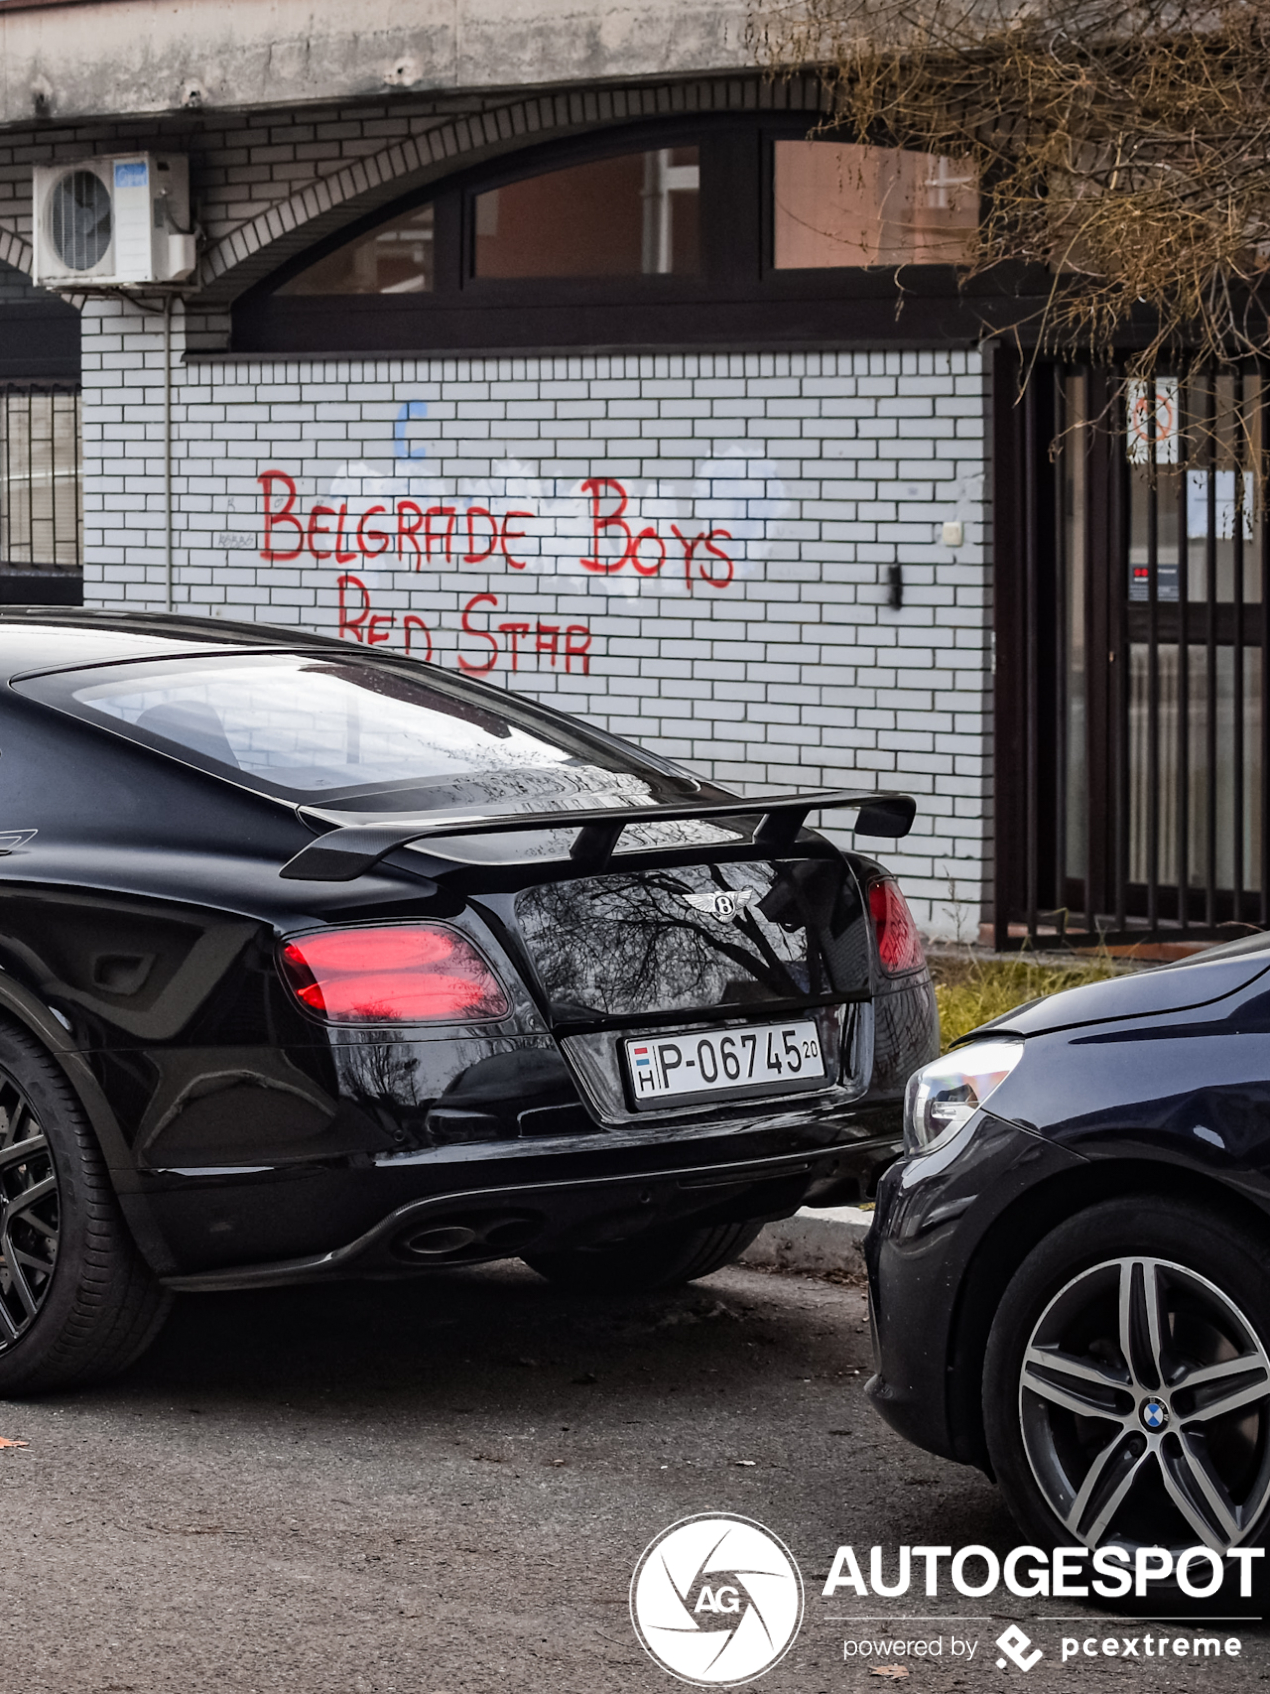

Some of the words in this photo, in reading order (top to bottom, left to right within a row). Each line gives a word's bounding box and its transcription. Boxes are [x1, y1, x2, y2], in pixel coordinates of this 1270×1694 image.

[256, 469, 536, 573] BELGRADE
[457, 591, 594, 677] STAR
[638, 1069, 655, 1092] H
[657, 1030, 802, 1089] P-06745
[802, 1040, 819, 1059] 20
